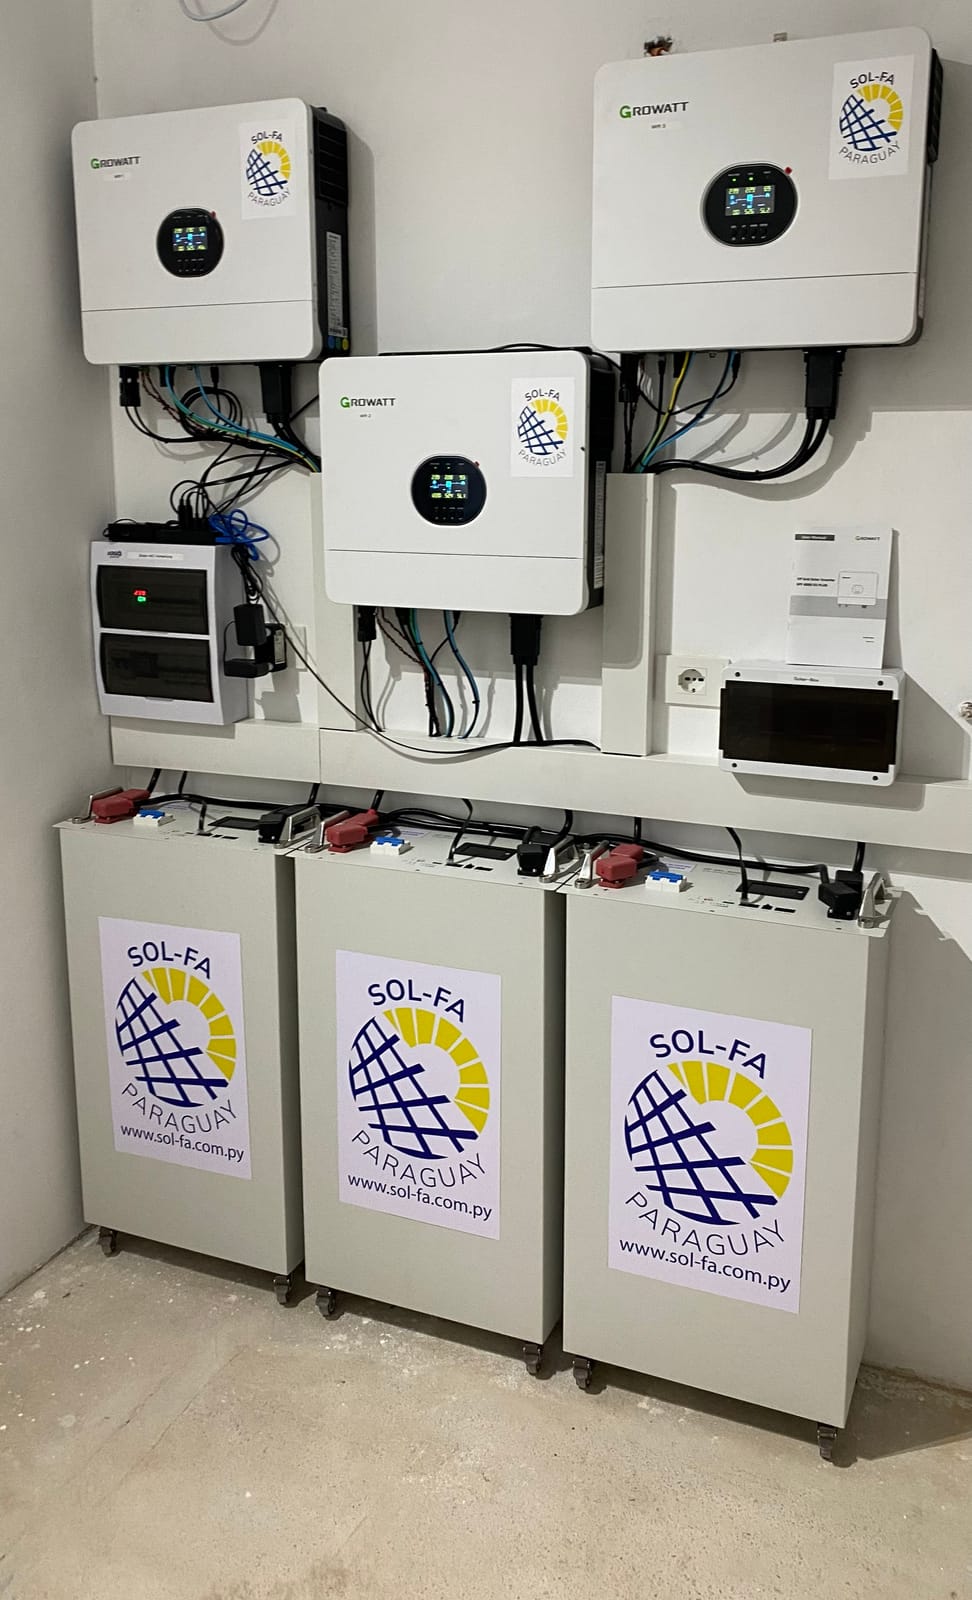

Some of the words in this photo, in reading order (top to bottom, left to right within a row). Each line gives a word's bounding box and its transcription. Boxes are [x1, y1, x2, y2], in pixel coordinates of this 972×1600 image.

[849, 71, 895, 89] SOL-FA
[619, 101, 689, 118] GROWATT
[251, 131, 283, 145] SOL-FA
[839, 141, 901, 164] PARAGUAY
[91, 156, 141, 169] GROWATT
[248, 188, 290, 207] PARAGUAY
[340, 397, 396, 408] GROWATT
[525, 388, 560, 401] SOL-FA
[518, 449, 567, 467] PARAGUAY
[127, 941, 211, 979] SOL-FA
[368, 979, 465, 1023] SOL-FA
[649, 1029, 767, 1079] SOL-FA
[122, 1082, 237, 1134] PARAGUAY
[120, 1125, 245, 1163] www.sol-fa.com.py
[351, 1129, 486, 1188] PARAGUAY
[347, 1174, 492, 1221] www.sol-fa.com.py
[625, 1190, 785, 1256] PARAGUAY
[619, 1239, 791, 1293] www.sol-fa.com.py
